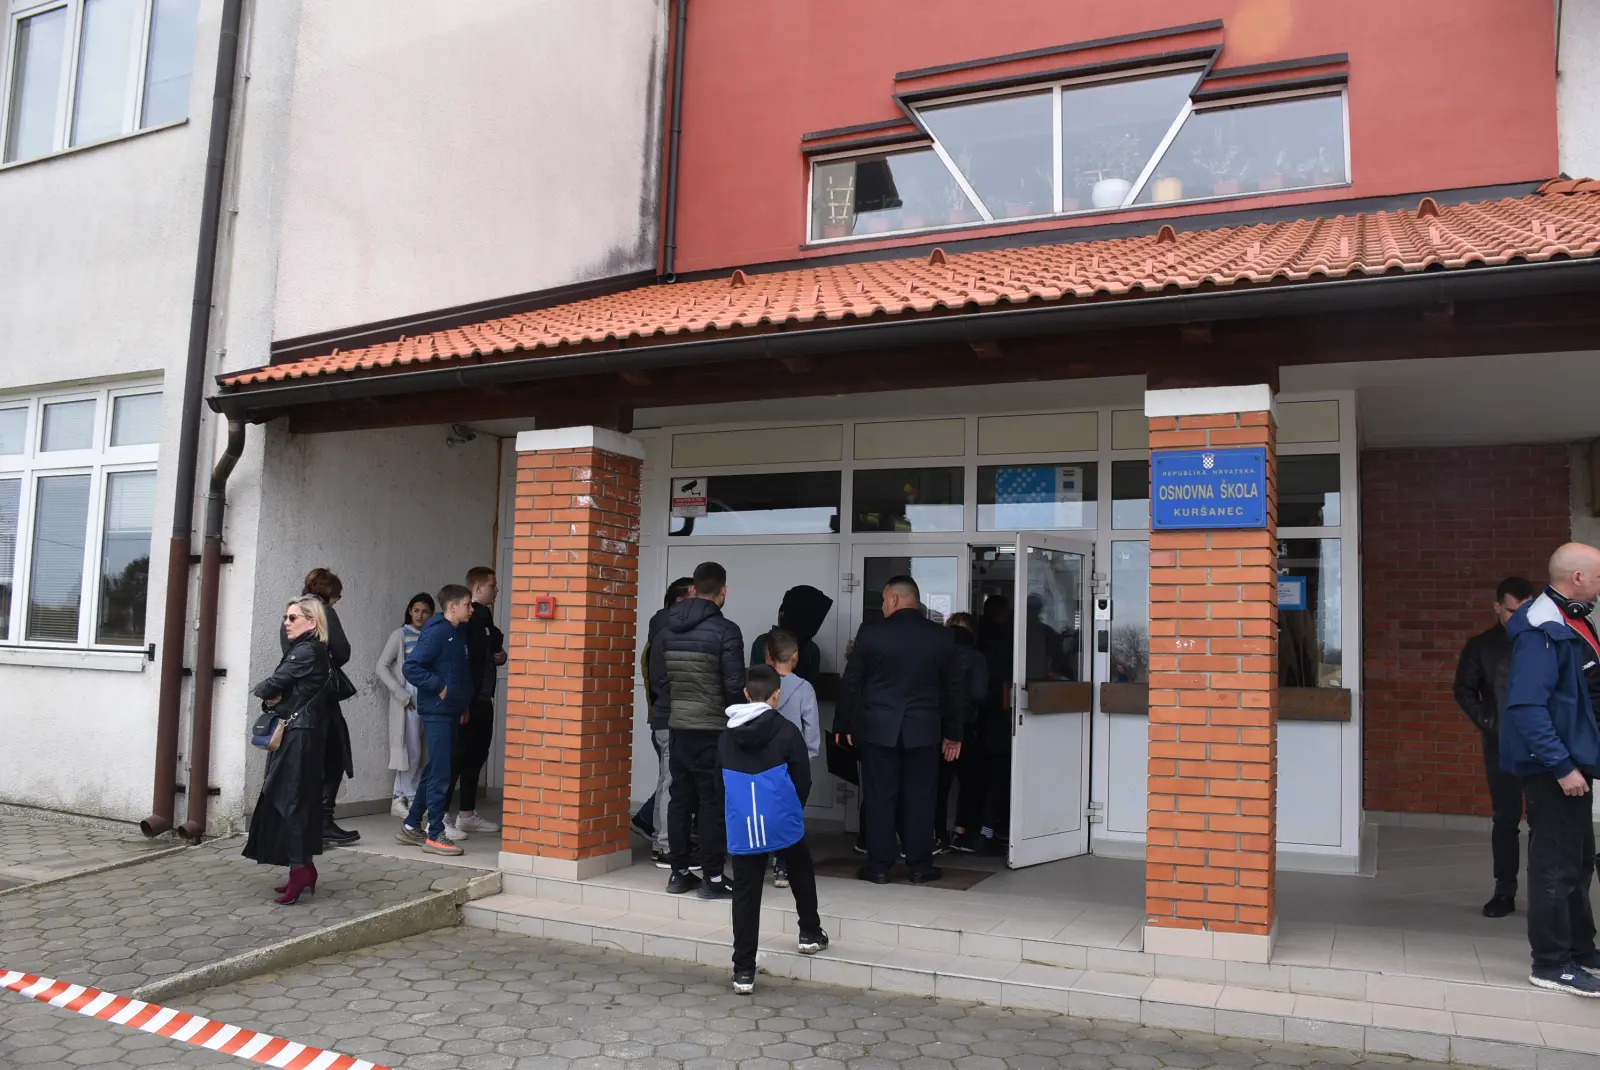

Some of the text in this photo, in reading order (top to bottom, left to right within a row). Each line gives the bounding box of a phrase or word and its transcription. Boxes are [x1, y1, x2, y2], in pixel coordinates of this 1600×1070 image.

[1159, 480, 1259, 500] OSNOVNA ŠKOLA
[1173, 505, 1244, 517] KURŠANEC
